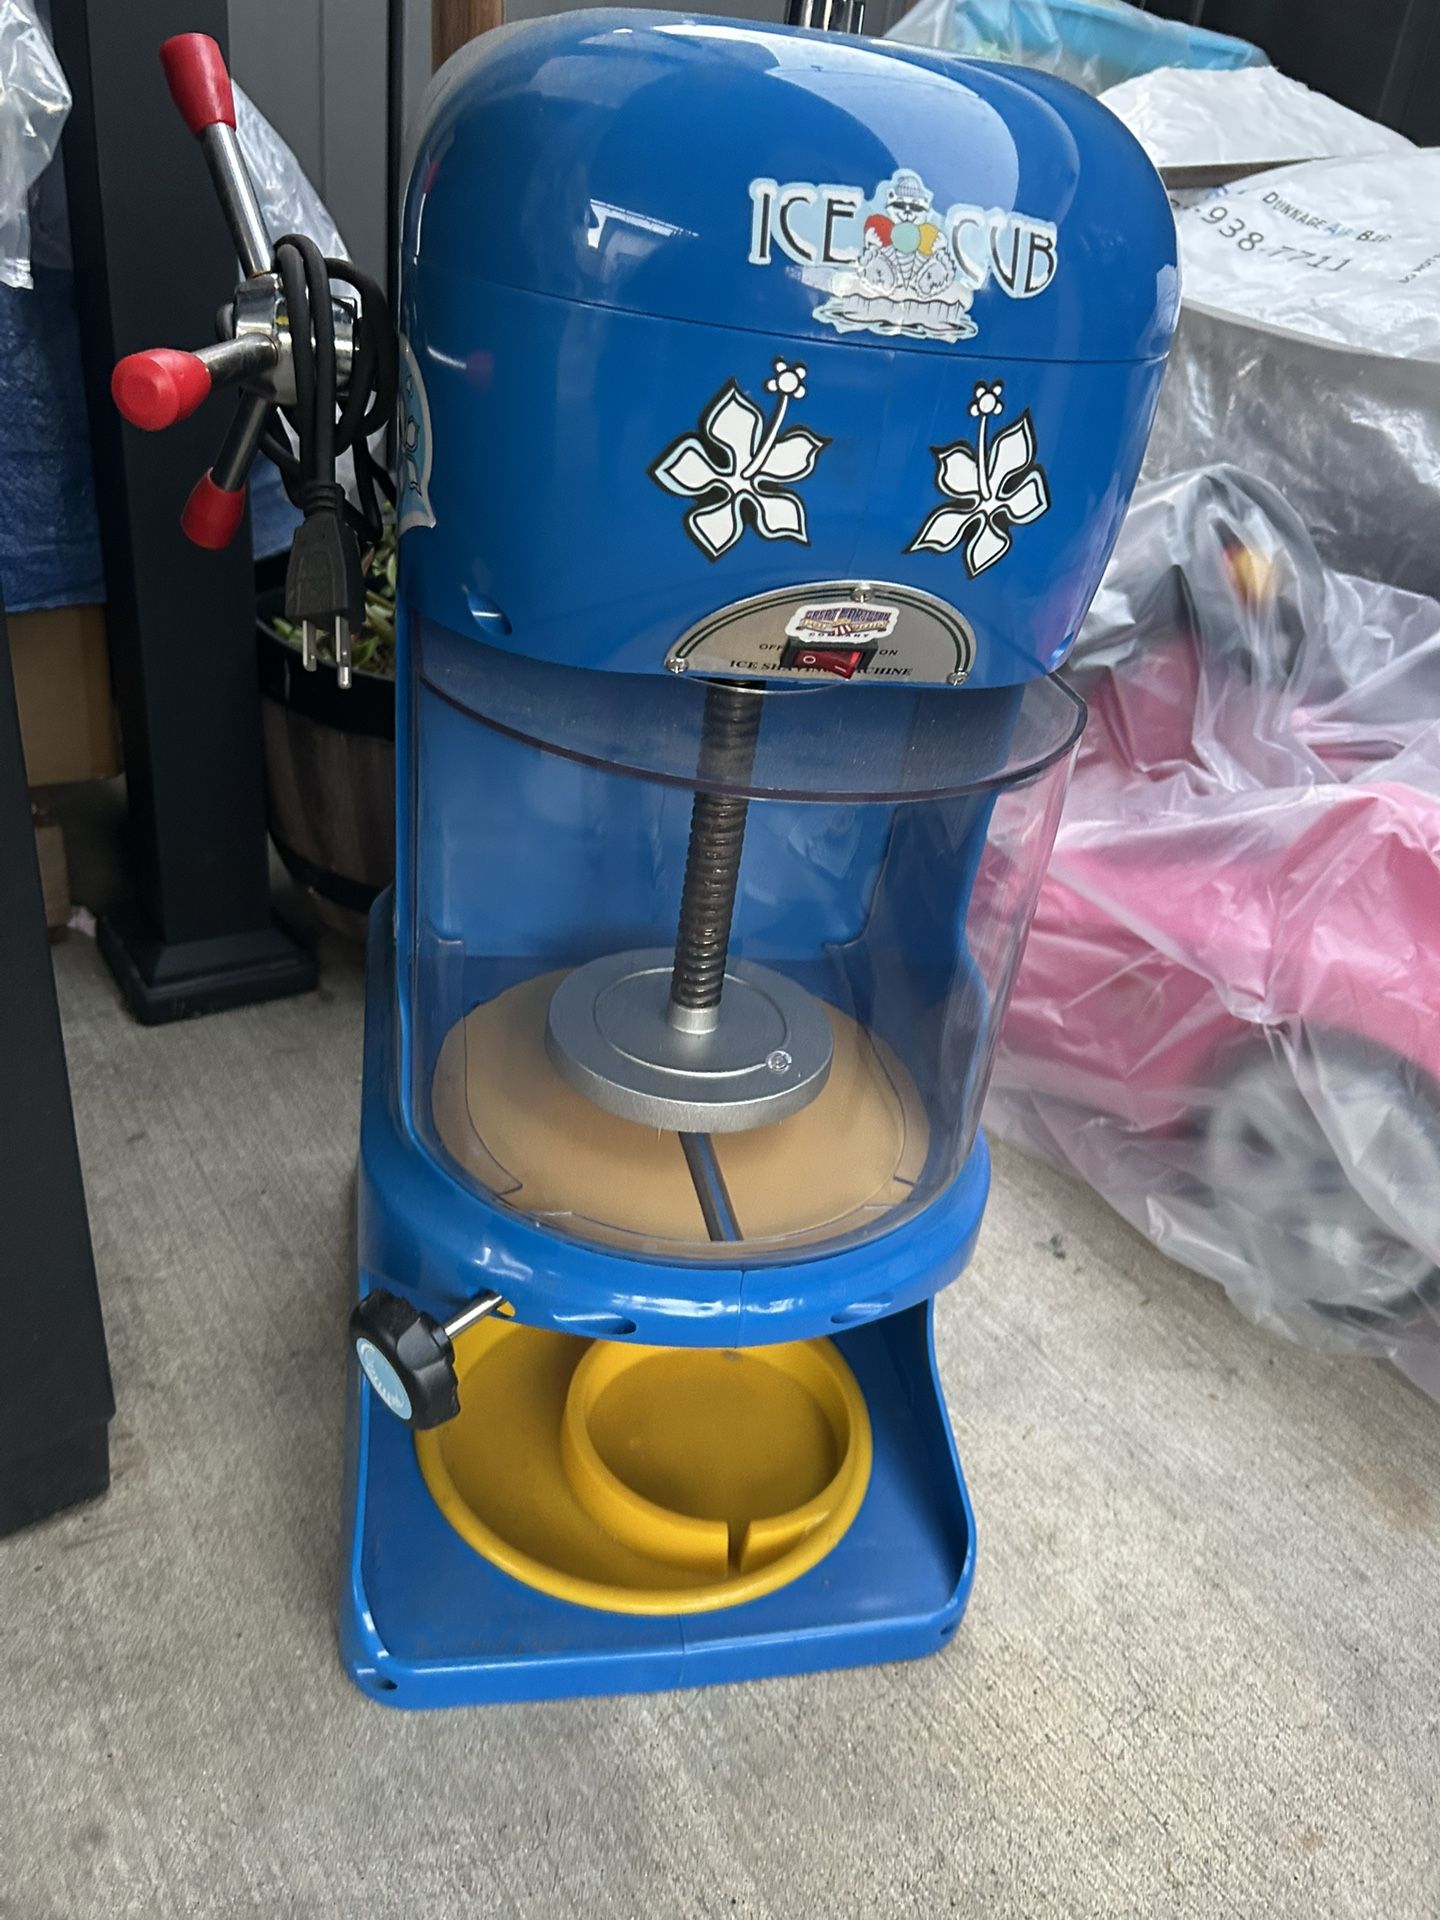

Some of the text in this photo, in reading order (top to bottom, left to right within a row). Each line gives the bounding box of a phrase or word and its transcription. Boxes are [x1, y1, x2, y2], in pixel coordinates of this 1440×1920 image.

[751, 180, 1056, 297] ICE CUB
[879, 648, 899, 656] ON
[729, 660, 757, 669] ICE
